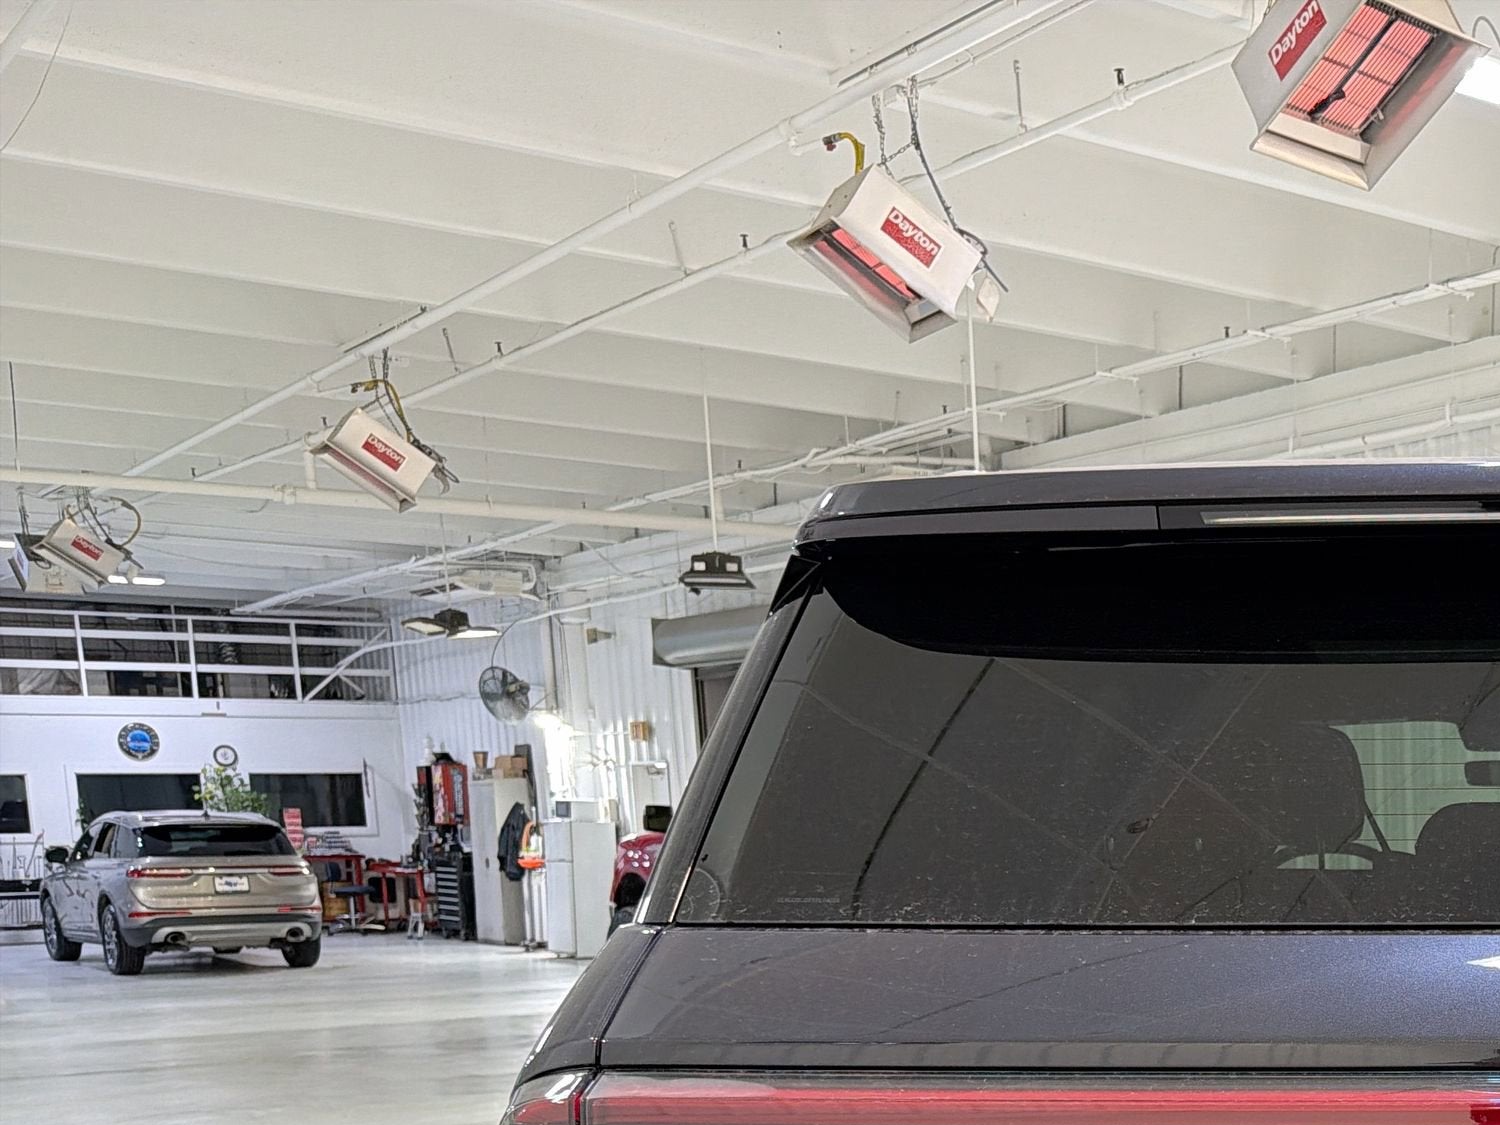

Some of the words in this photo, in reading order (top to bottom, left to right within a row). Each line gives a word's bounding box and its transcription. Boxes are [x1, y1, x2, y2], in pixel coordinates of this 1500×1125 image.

[1270, 0, 1319, 65] Dayton
[889, 209, 939, 256] Dayton
[367, 435, 404, 464] Dayton
